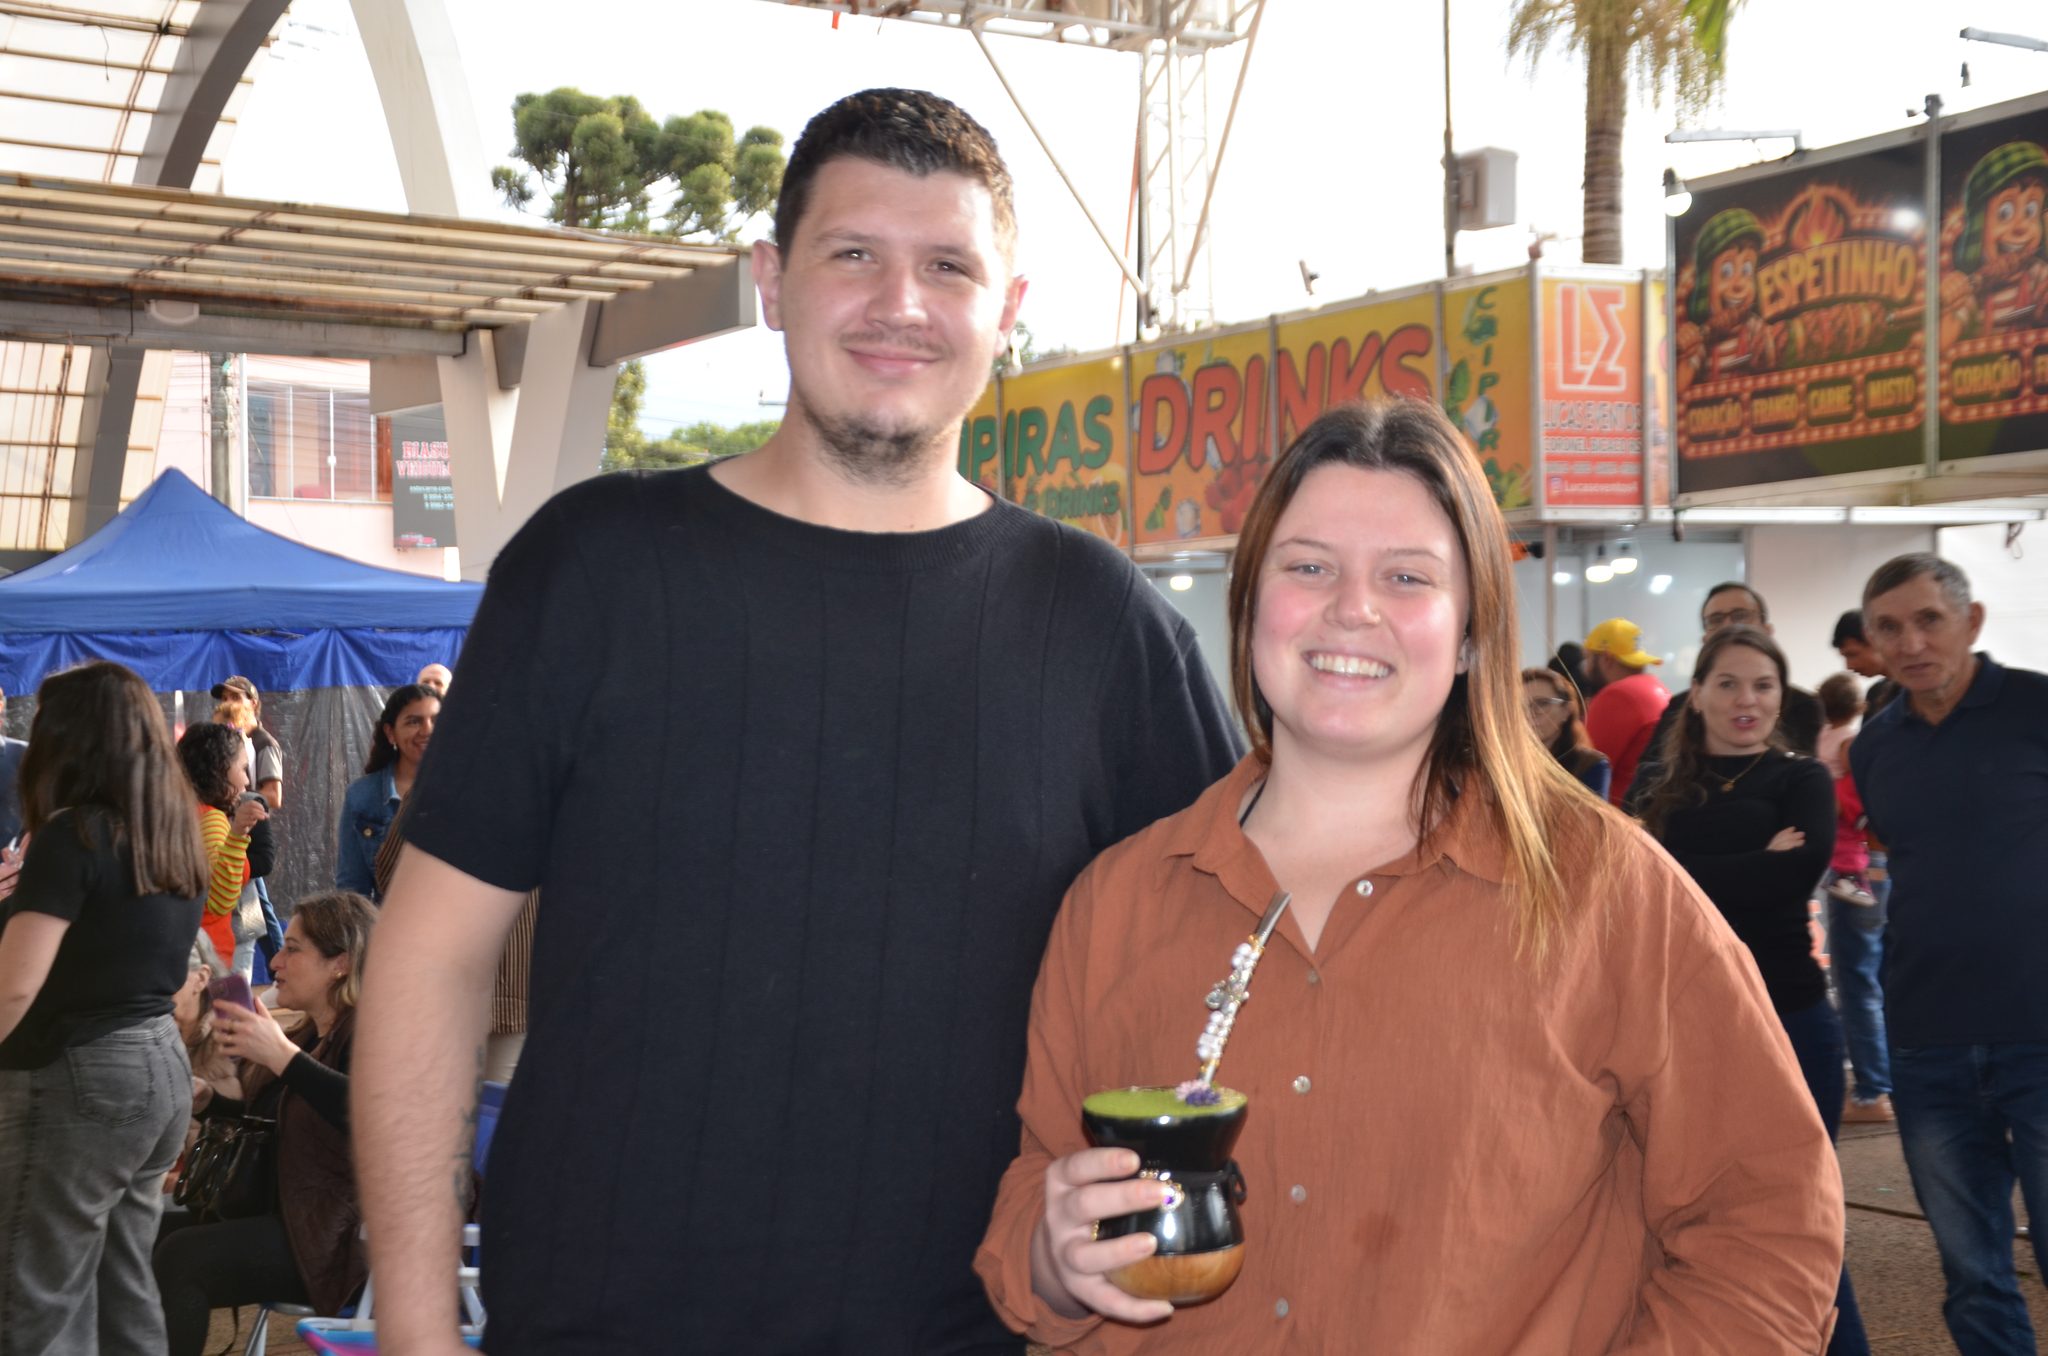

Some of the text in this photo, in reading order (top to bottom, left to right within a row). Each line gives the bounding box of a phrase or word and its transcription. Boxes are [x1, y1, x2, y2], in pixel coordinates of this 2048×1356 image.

[1758, 240, 1918, 322] ESPETINHO
[1137, 323, 1433, 475] DRINKS
[1807, 383, 1854, 418] CARNE
[1867, 374, 1915, 408] MISTO
[1953, 355, 2020, 399] CORAÇÃO
[1544, 402, 1642, 430] LUCAS EVENTOS
[1045, 480, 1120, 518] DRINKS
